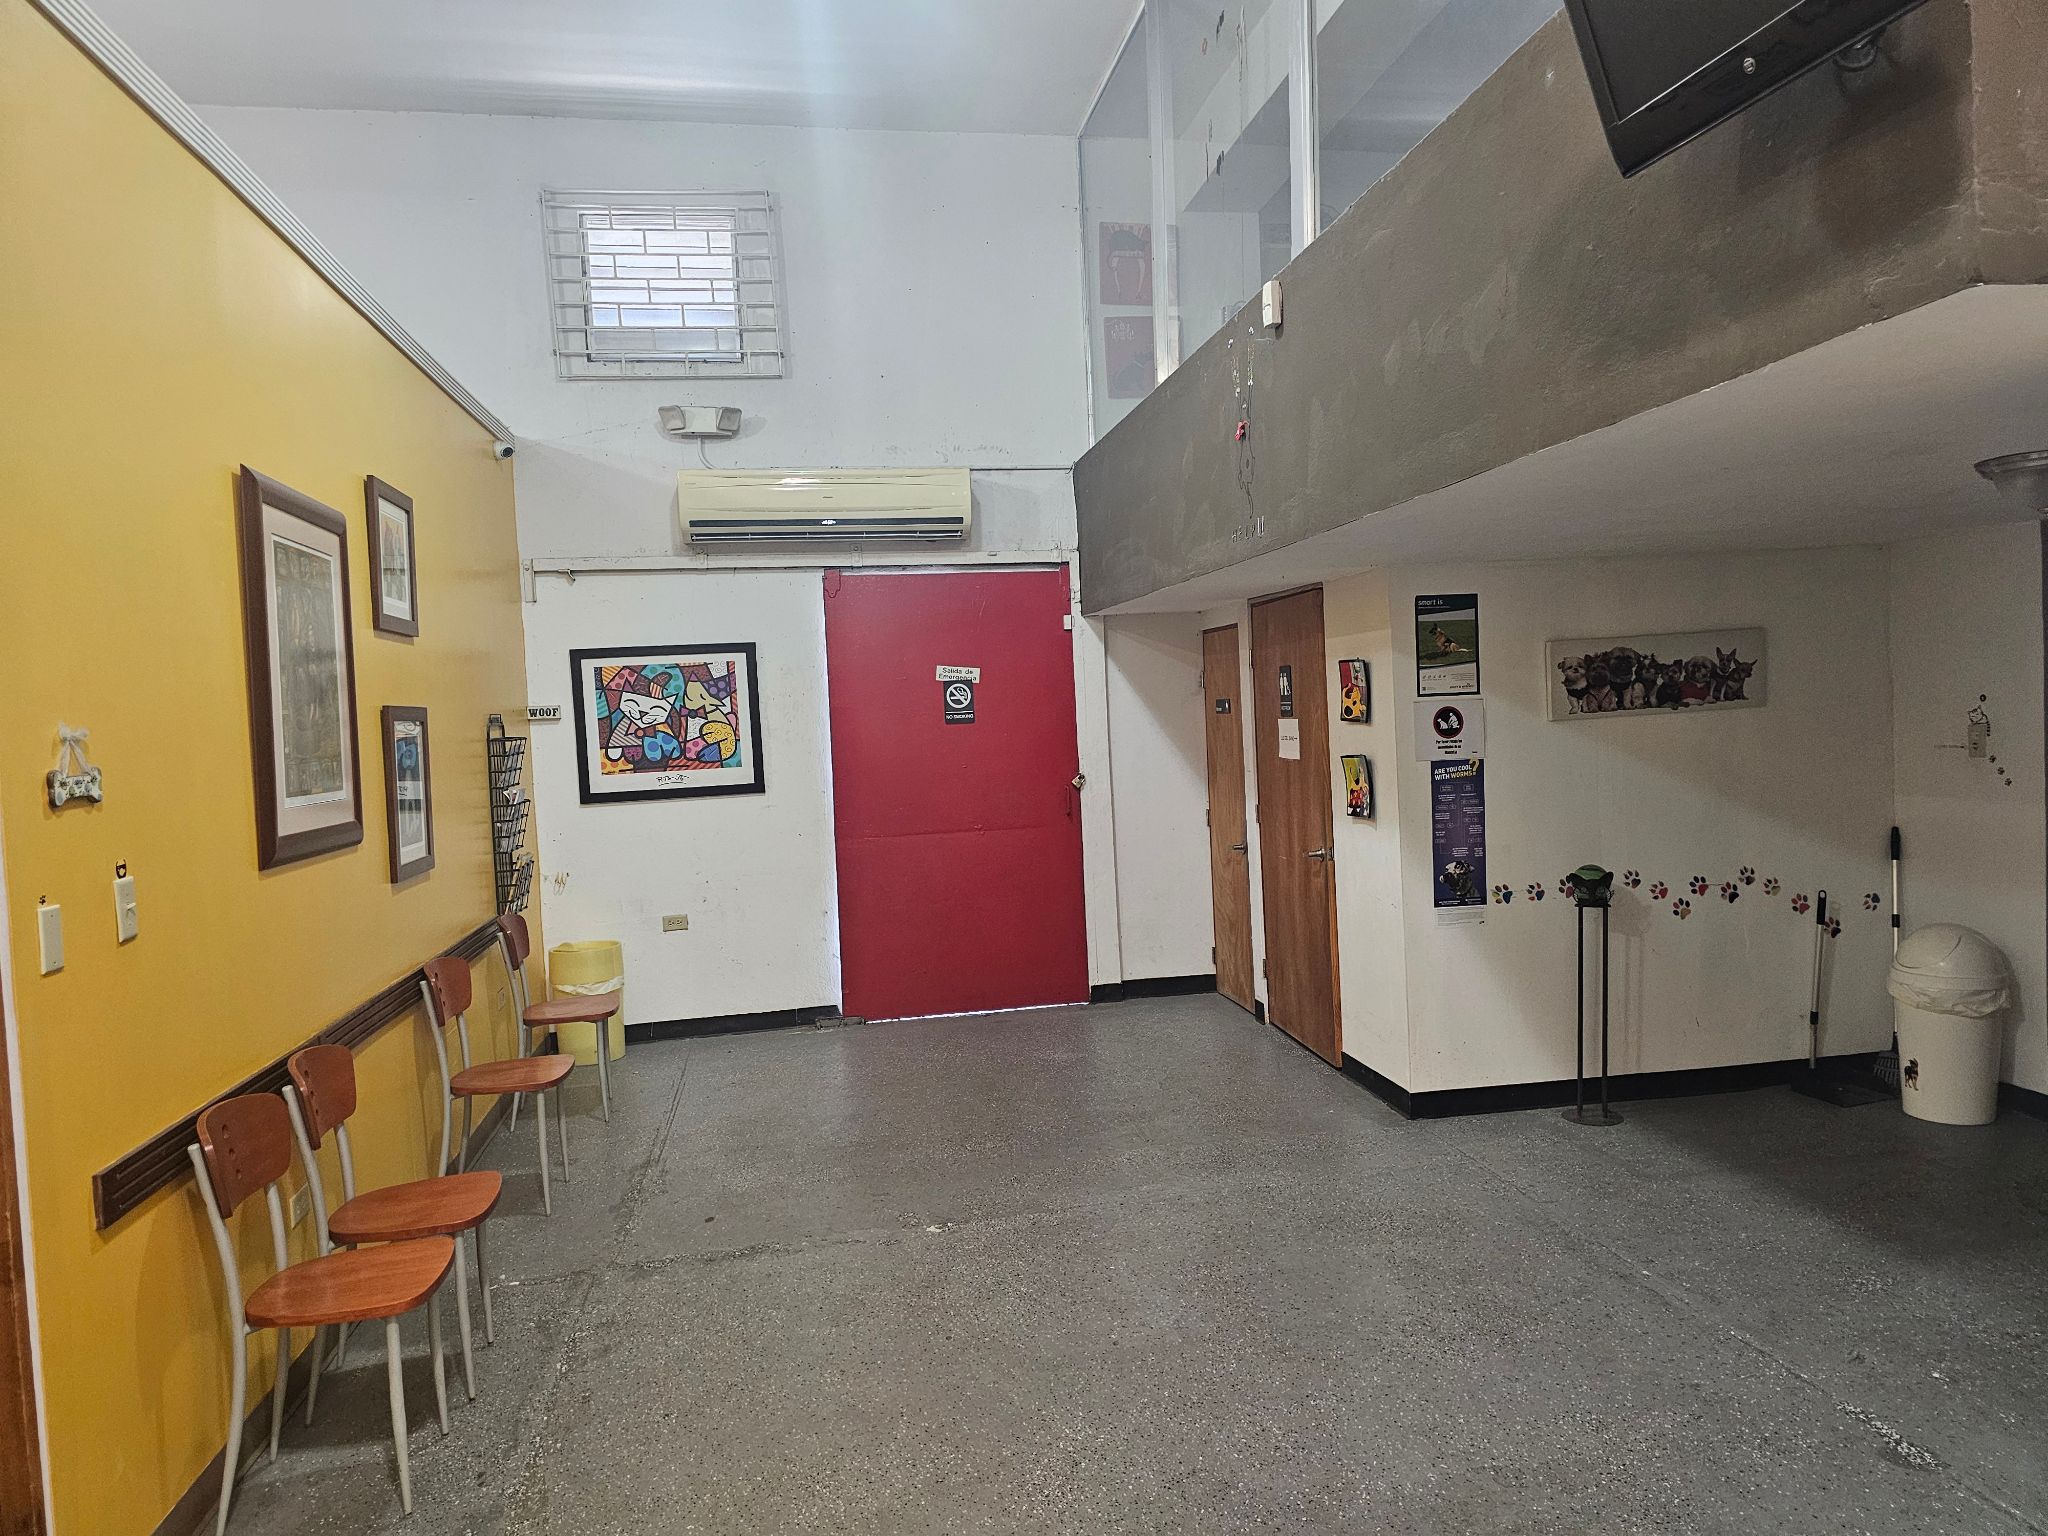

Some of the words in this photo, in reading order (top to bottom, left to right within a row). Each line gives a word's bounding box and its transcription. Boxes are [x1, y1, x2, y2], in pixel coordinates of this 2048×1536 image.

[942, 667, 962, 675] Salida
[528, 707, 558, 718] WOOF
[1434, 767, 1446, 775] ARE
